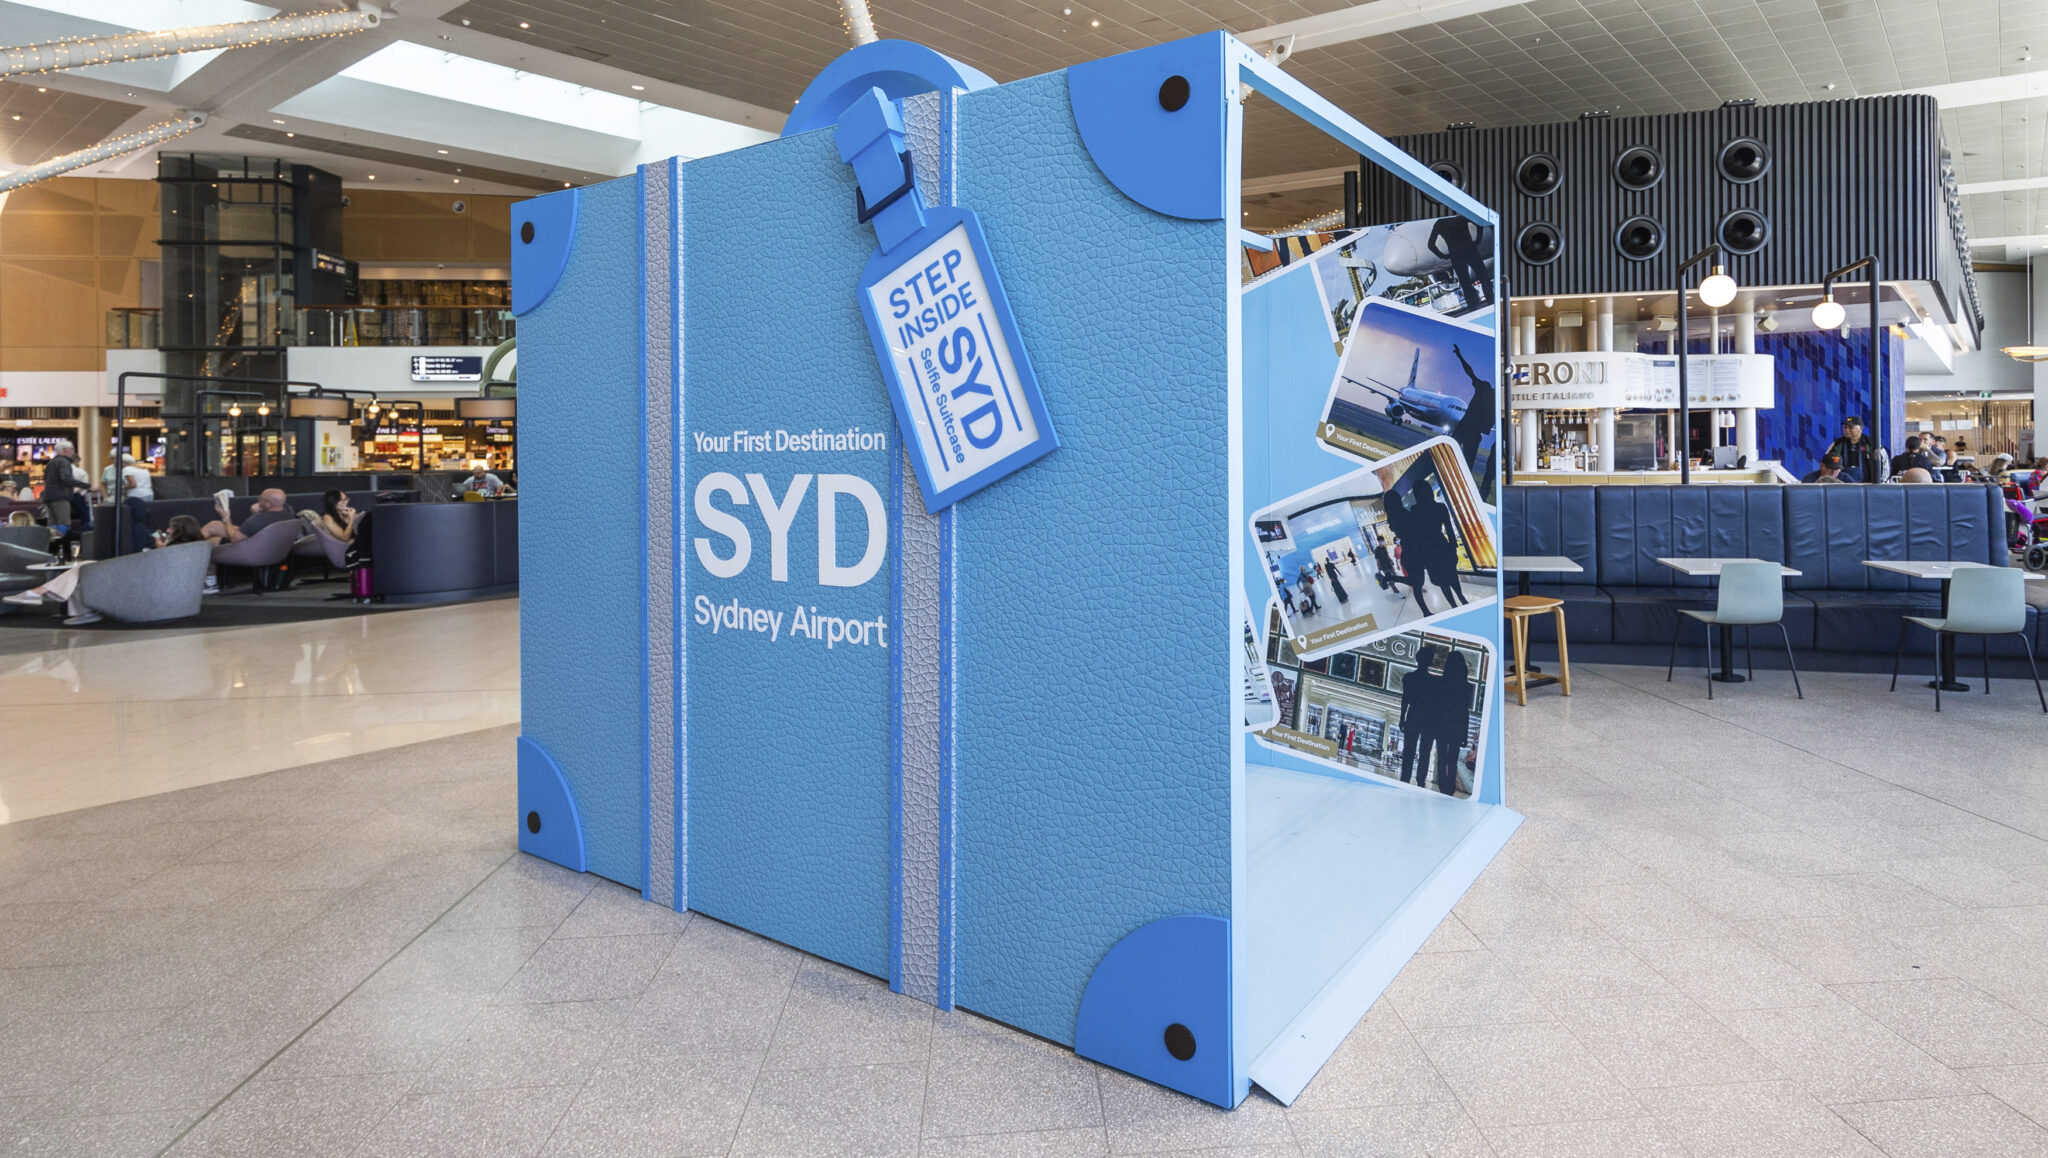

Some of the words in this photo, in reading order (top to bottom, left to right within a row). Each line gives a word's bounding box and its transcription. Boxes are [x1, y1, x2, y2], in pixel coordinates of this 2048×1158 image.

[889, 249, 961, 319] STEP
[898, 281, 977, 349] INSIDE
[938, 326, 1003, 450] SYD
[1511, 361, 1608, 386] ERONI
[920, 347, 941, 393] Selfie
[936, 394, 965, 464] Suitcase
[693, 432, 731, 452] Your
[733, 430, 771, 452] First
[775, 427, 886, 452] Destination
[1337, 434, 1349, 442] Your
[1349, 438, 1362, 447] First
[1362, 443, 1391, 456] Destinatio
[693, 471, 888, 588] SYD
[694, 595, 783, 642] Sydney
[790, 605, 888, 649] Airport
[1310, 637, 1323, 645] Your
[1323, 632, 1336, 640] First
[1336, 622, 1368, 635] Destination
[1271, 729, 1283, 737] Your
[1284, 732, 1296, 741] First
[1297, 737, 1330, 750] Destination
